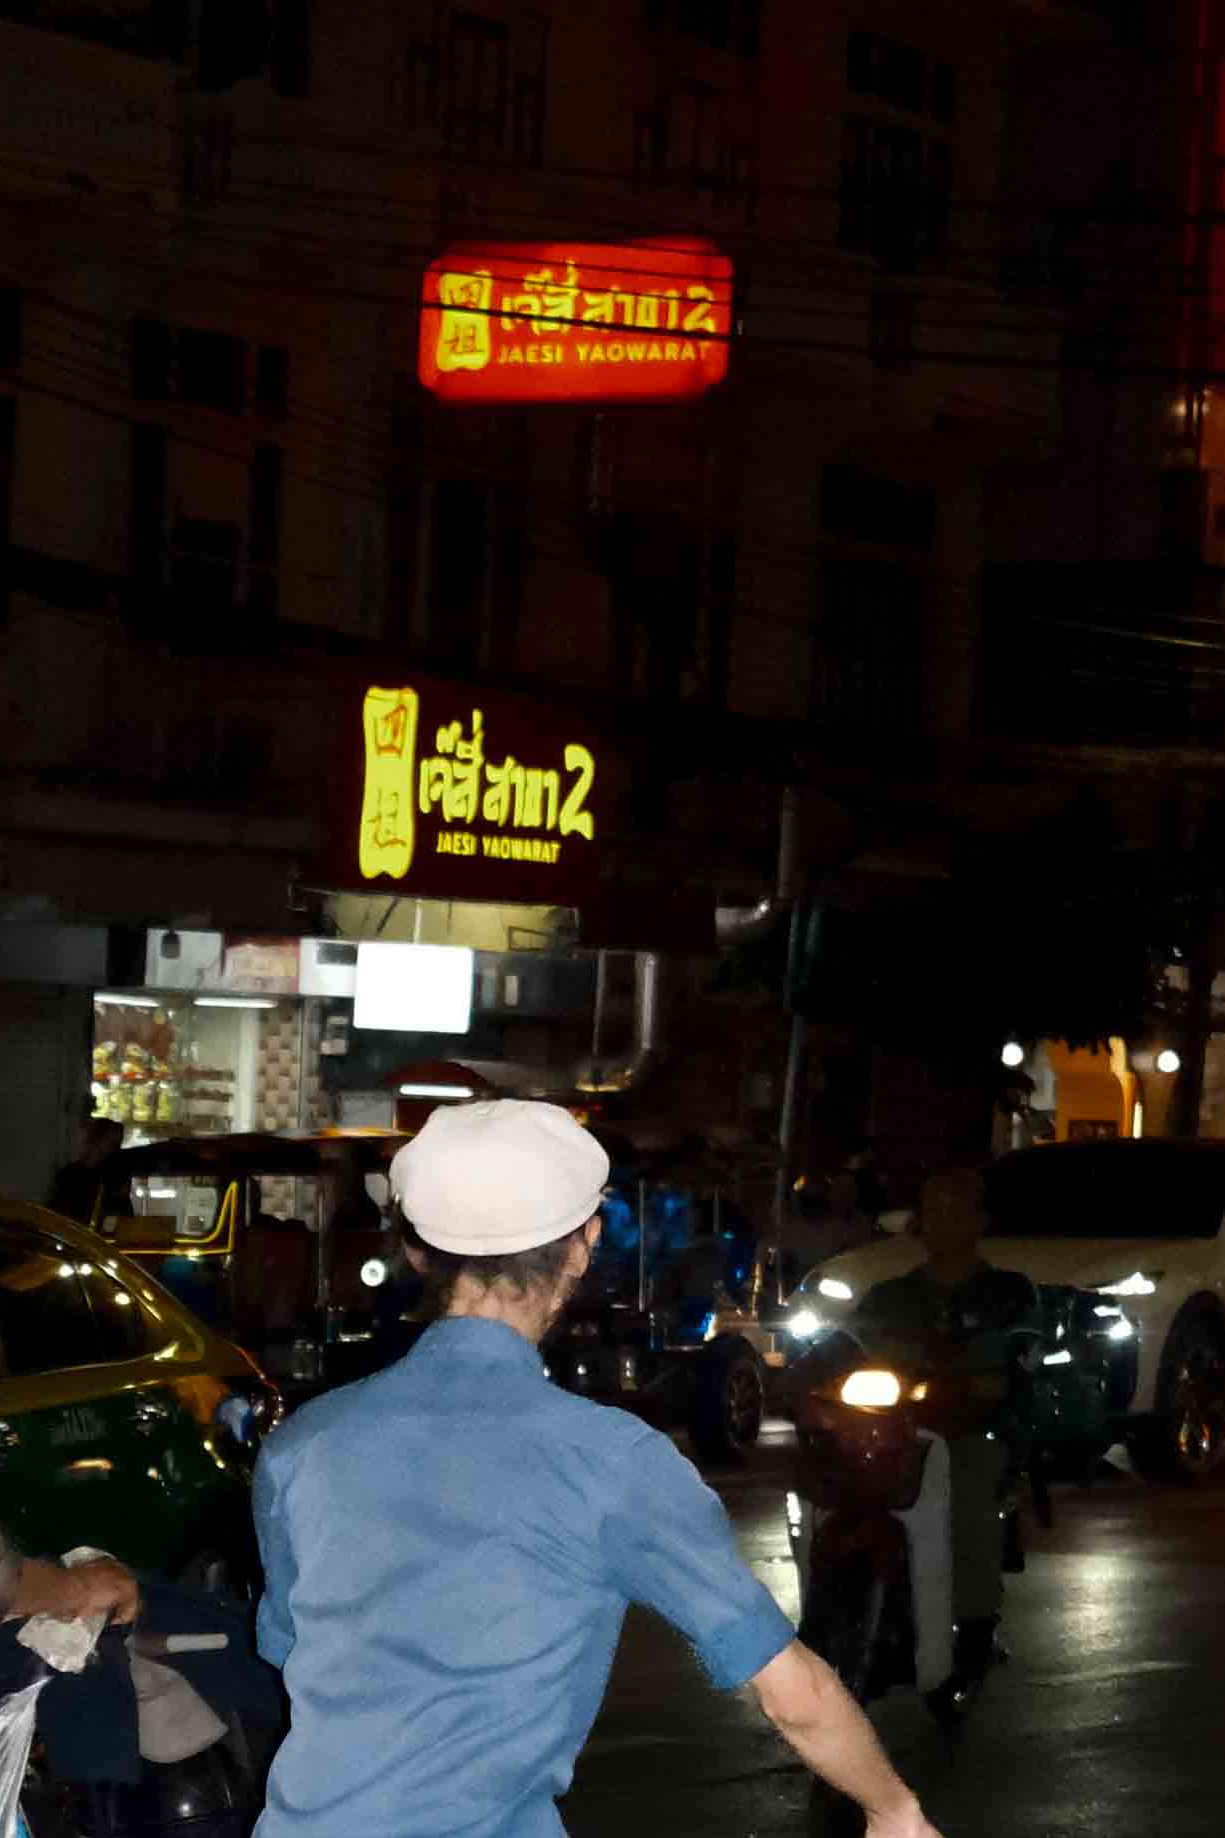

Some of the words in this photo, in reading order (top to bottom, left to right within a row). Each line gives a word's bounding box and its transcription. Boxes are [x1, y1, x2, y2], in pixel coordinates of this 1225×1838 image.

[497, 342, 563, 364] JAESI
[576, 340, 711, 363] YAOWARAT
[436, 832, 476, 855] JAESI
[482, 836, 560, 863] YAOWARAT
